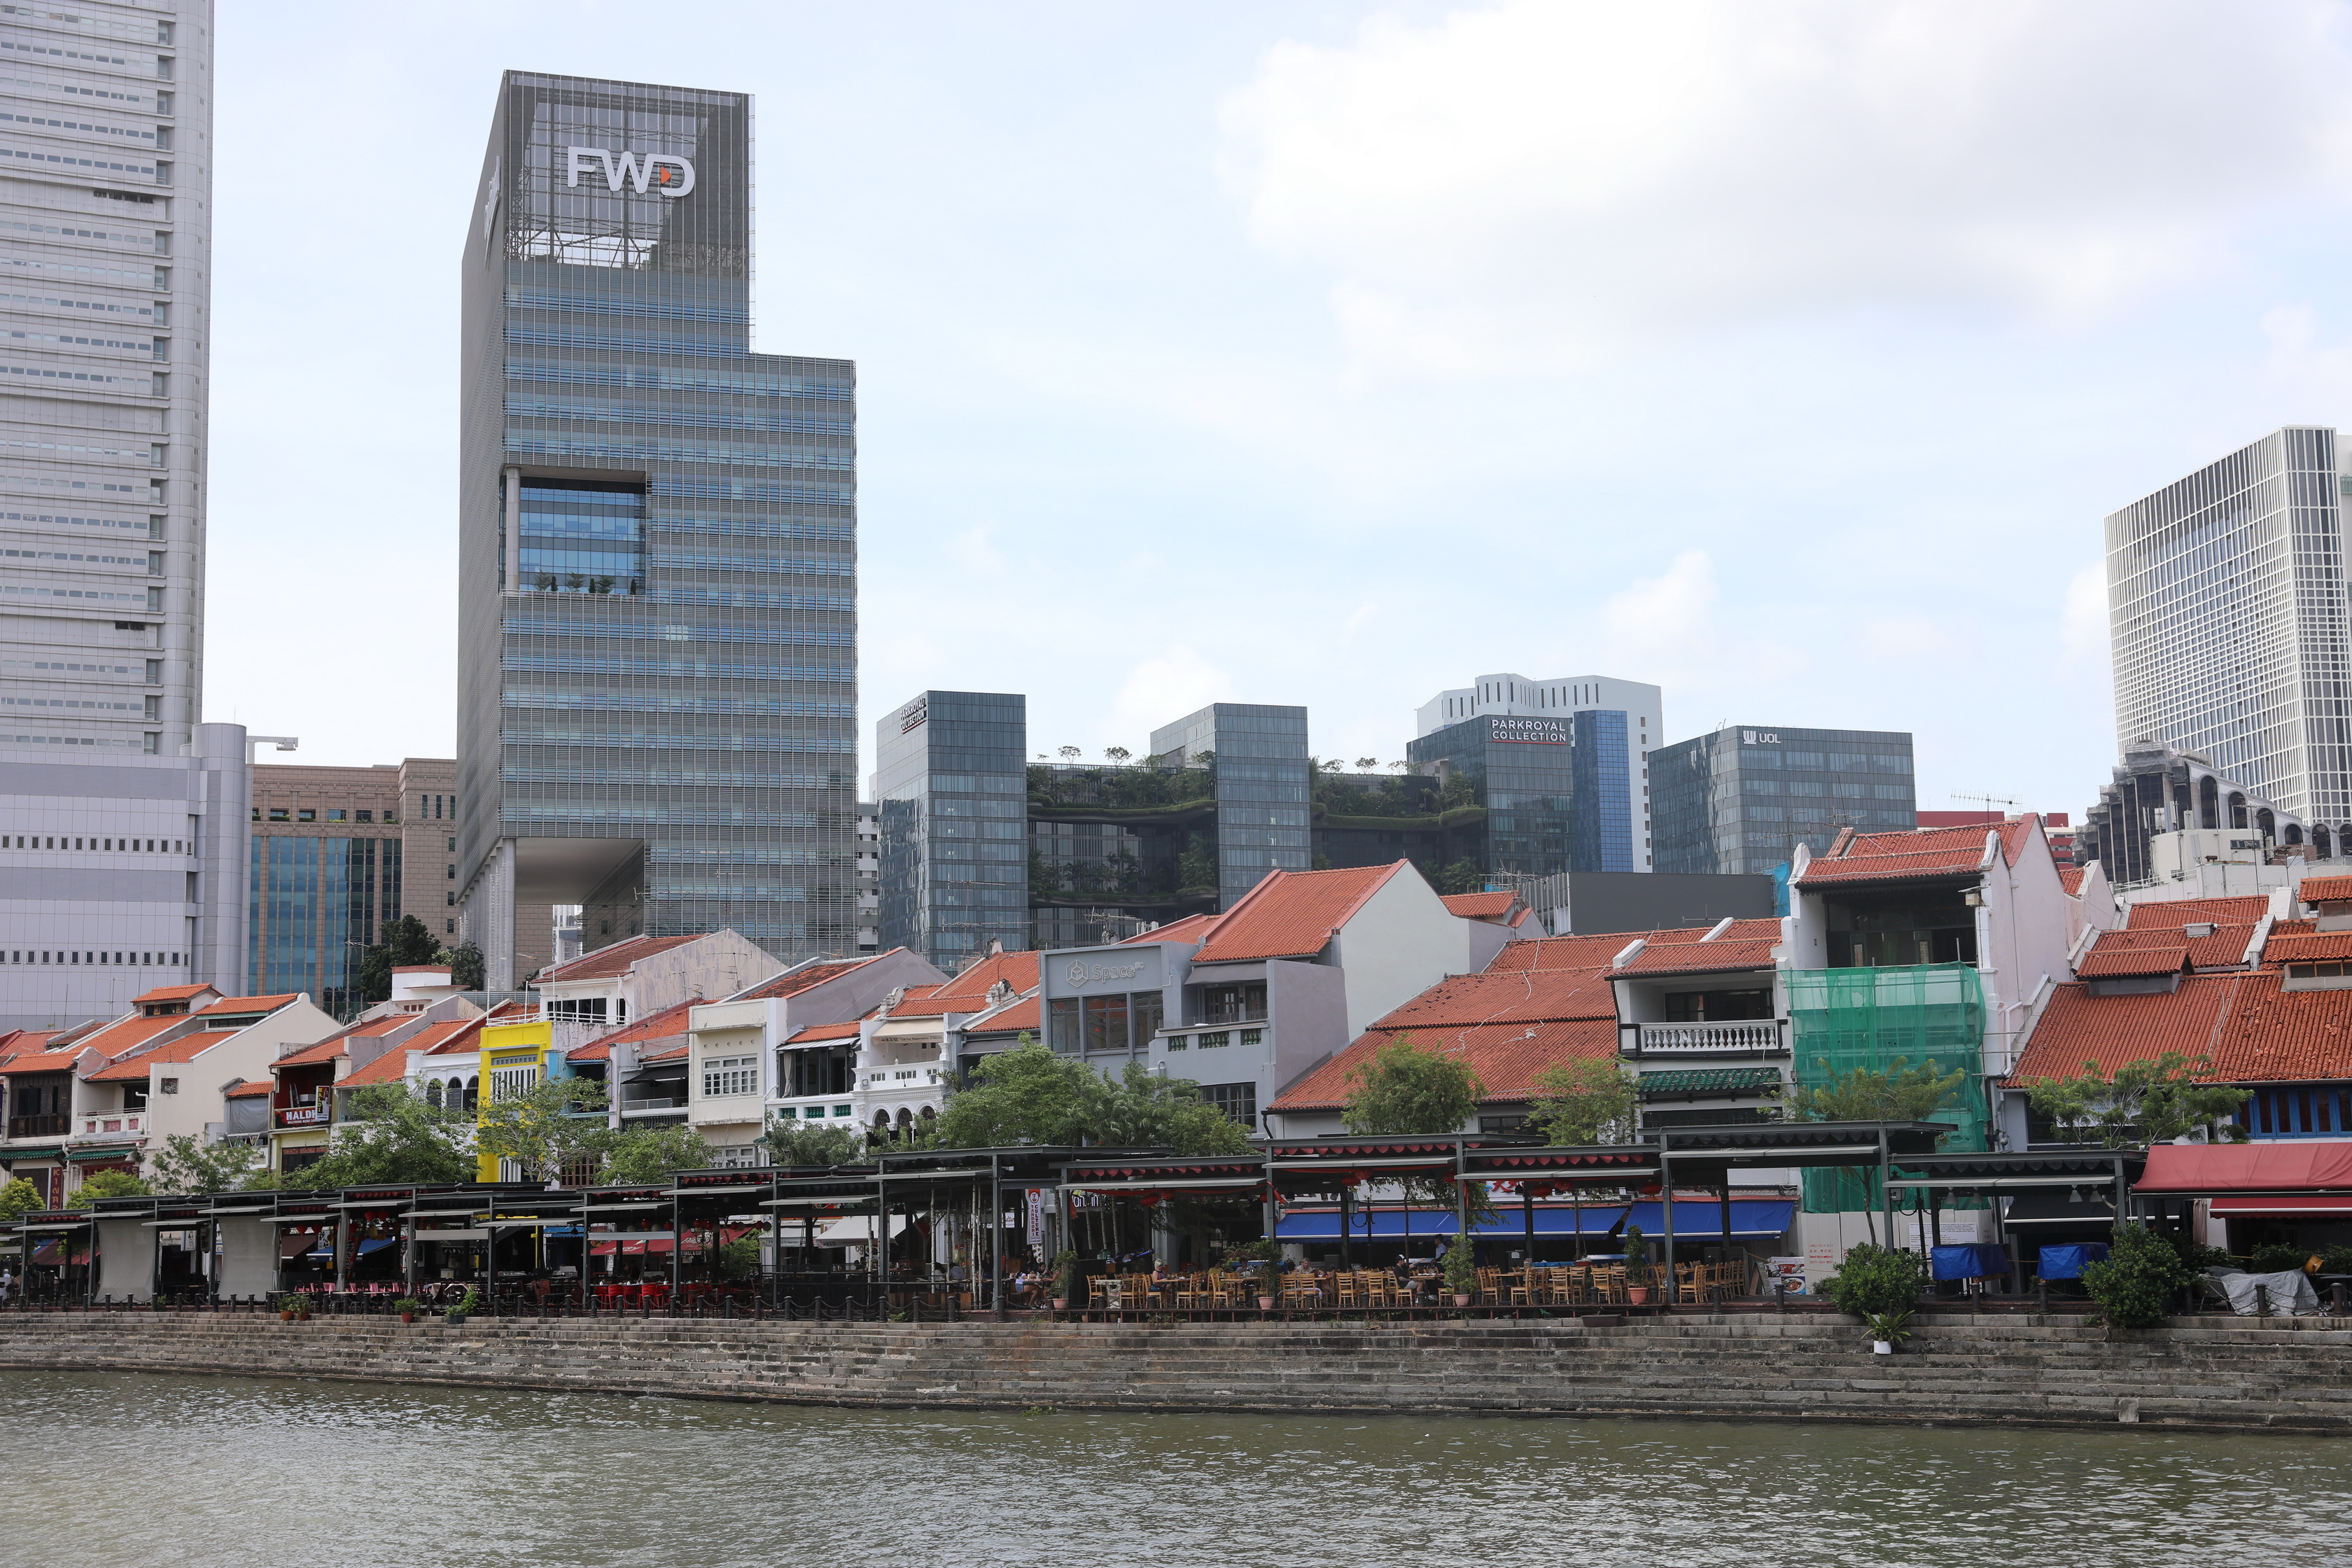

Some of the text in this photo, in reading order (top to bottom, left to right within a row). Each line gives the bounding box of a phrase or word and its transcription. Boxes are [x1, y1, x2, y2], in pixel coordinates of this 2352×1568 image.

[568, 146, 695, 197] FWD
[900, 698, 926, 720] PARKROYAL
[900, 709, 926, 731] COLLECTION
[1492, 720, 1565, 732] PARKROYAL
[1492, 731, 1565, 742] COLLECTION
[1759, 733, 1781, 743] UOL
[1093, 965, 1135, 983] Space
